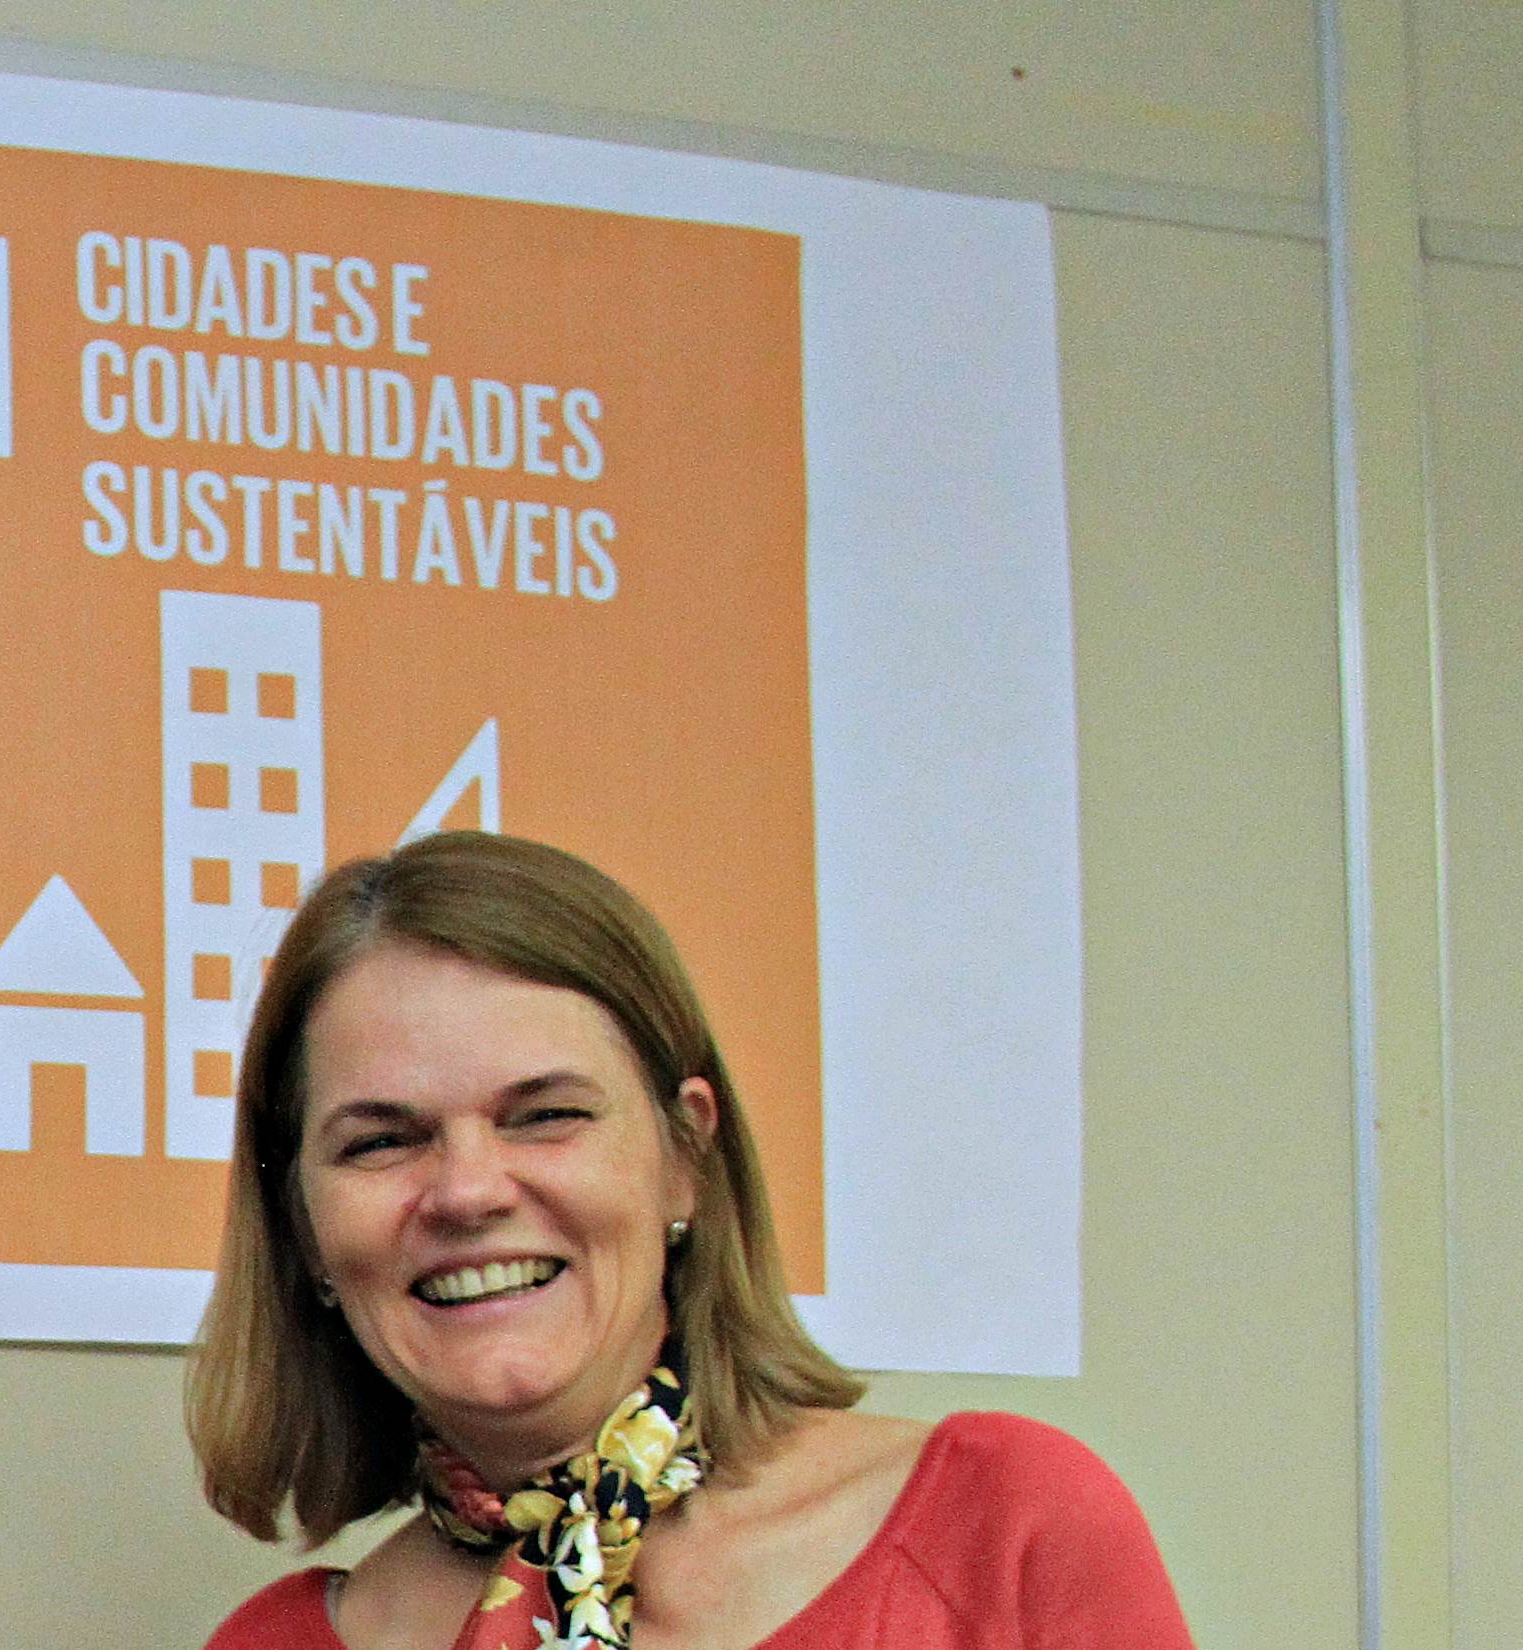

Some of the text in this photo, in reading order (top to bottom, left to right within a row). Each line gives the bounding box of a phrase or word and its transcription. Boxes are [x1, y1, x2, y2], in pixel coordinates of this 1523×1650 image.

[76, 230, 431, 355] CIDADES E
[81, 338, 604, 481] COMUNIDADES
[82, 460, 619, 602] SUSTENTÁVEIS
